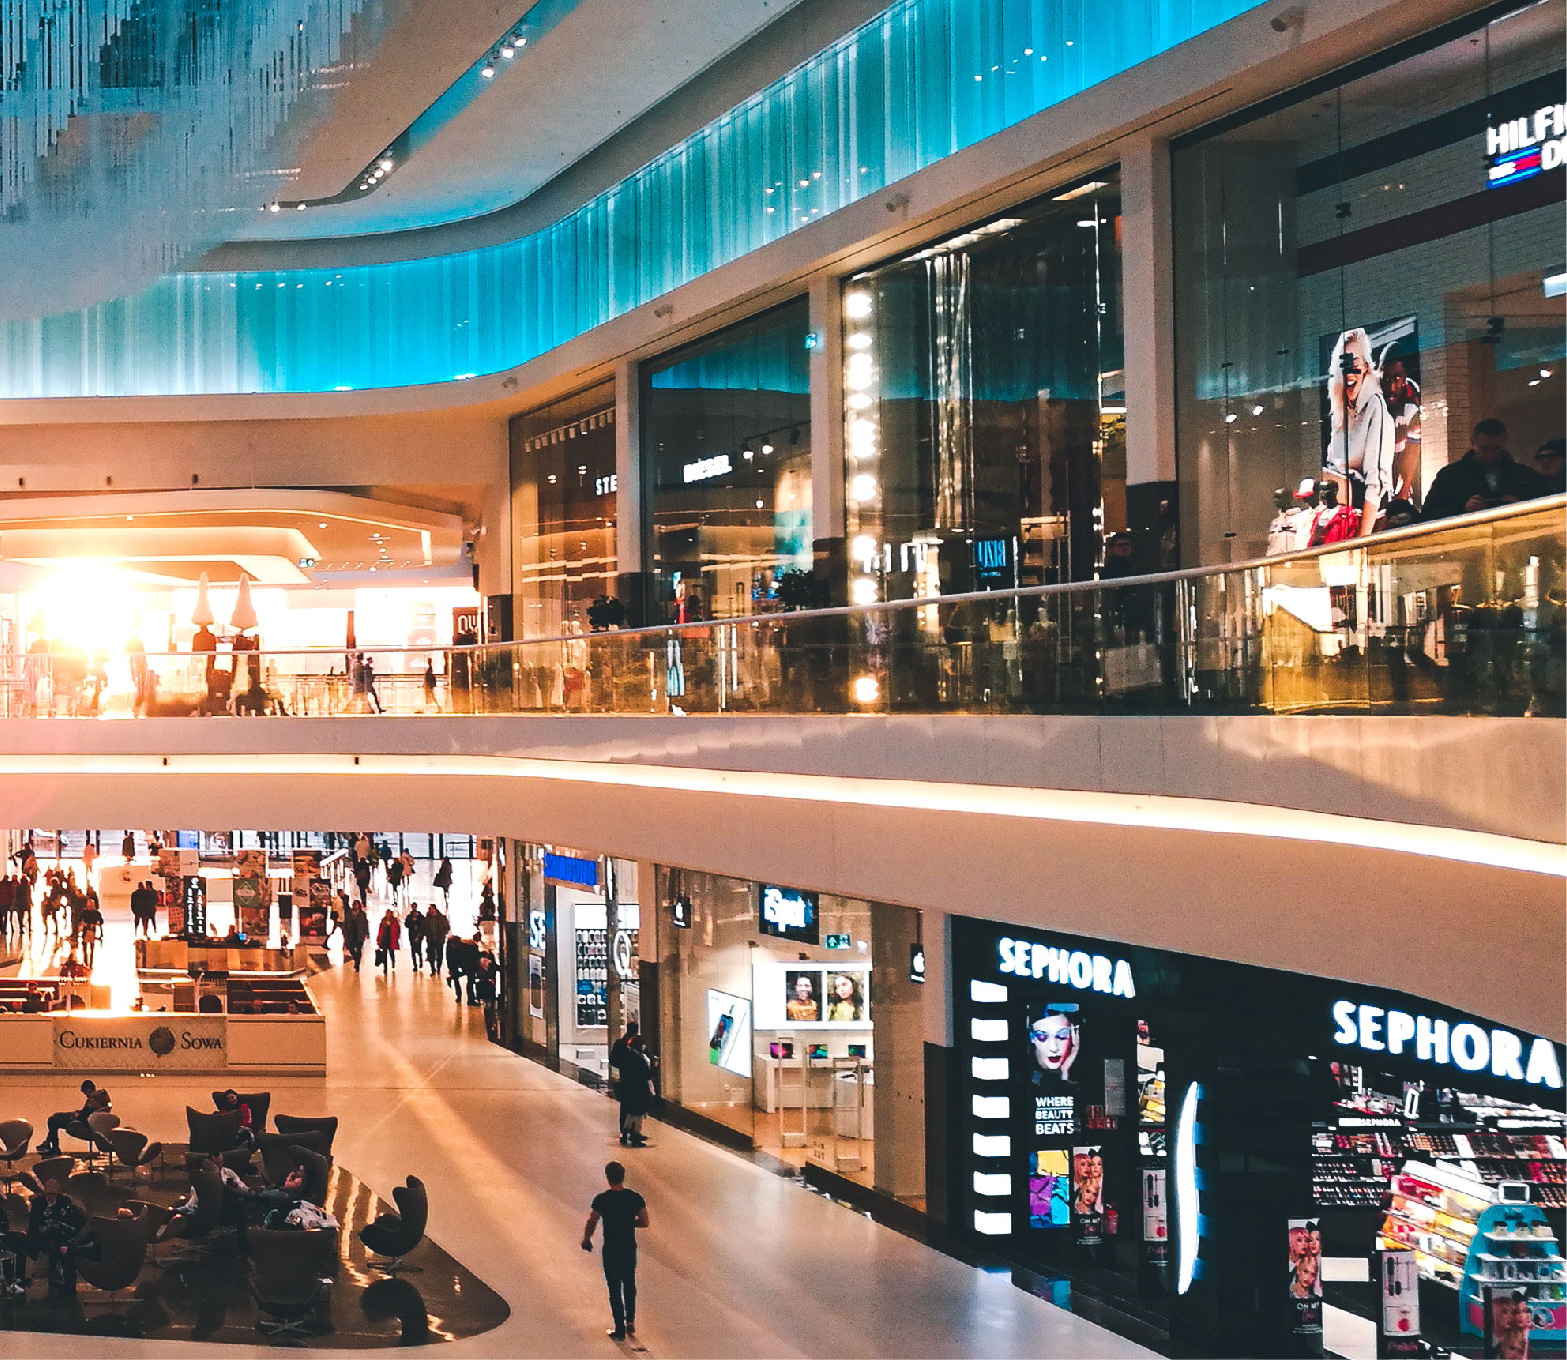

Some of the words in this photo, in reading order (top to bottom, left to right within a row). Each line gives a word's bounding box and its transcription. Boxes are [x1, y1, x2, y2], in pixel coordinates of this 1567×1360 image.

[1487, 103, 1566, 155] HILFI
[999, 937, 1136, 999] SEPHORA
[59, 1030, 142, 1049] CUKIERNIA
[1333, 1000, 1564, 1089] SEPHORA
[1035, 1096, 1074, 1108] WHERE
[1035, 1109, 1074, 1120] BEAUTY
[1035, 1122, 1075, 1135] BEATS
